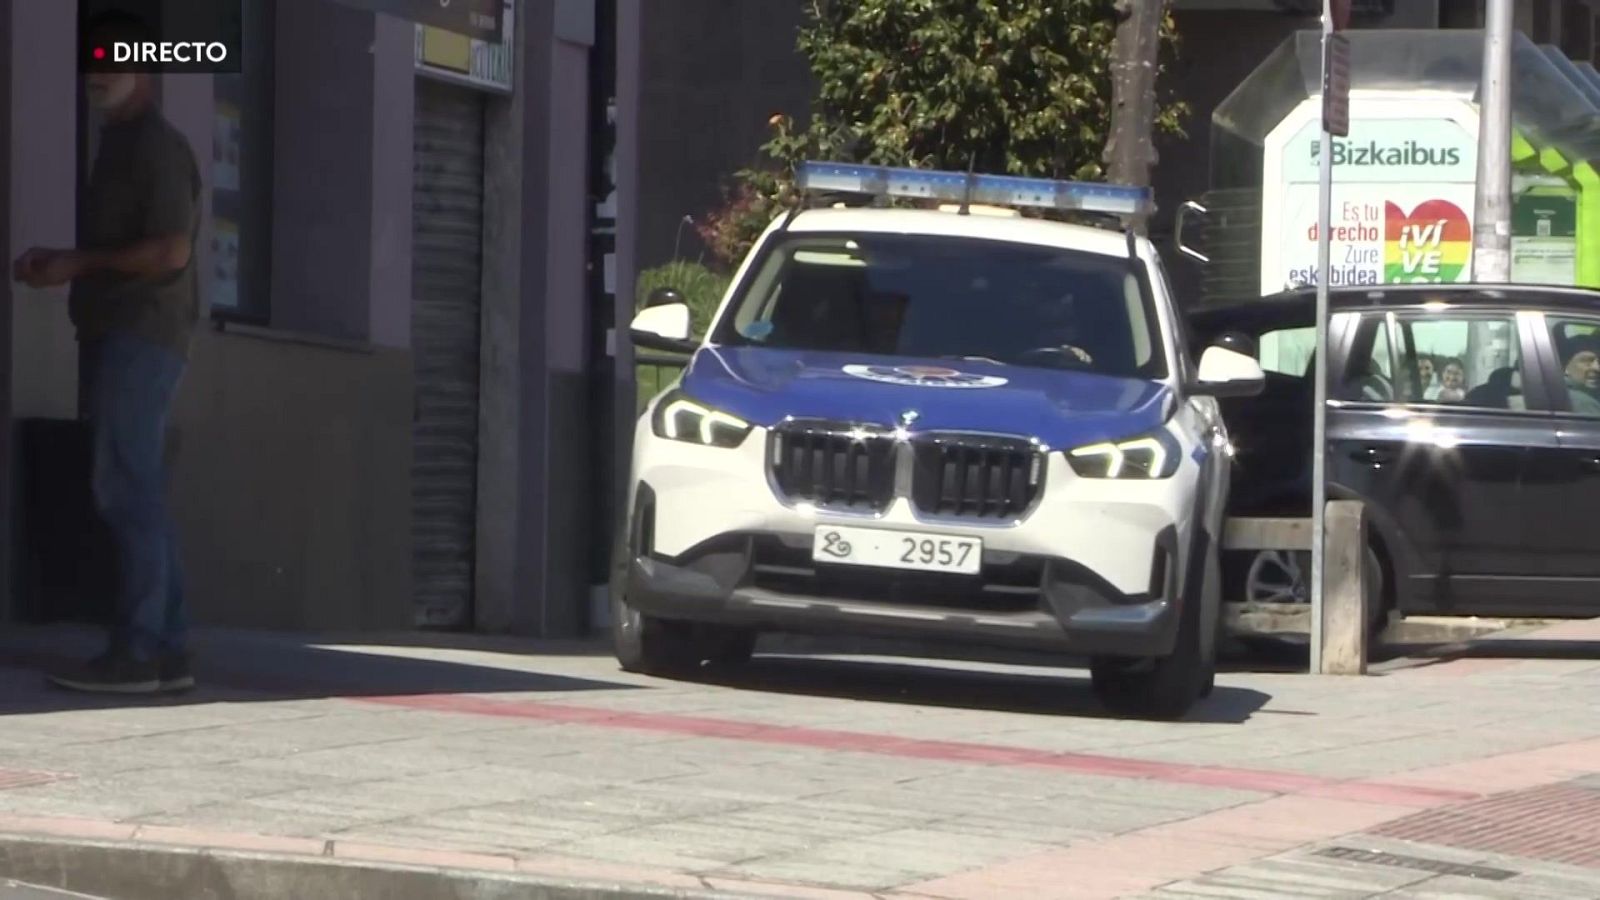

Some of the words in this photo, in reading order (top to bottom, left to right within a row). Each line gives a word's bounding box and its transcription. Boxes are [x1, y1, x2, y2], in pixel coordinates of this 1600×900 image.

[1331, 140, 1460, 166] Bizkaibus
[1343, 201, 1360, 221] Es
[1364, 203, 1379, 221] tu
[1308, 221, 1379, 242] drecho
[1345, 244, 1379, 264] Zure
[1402, 250, 1443, 274] VE
[1289, 264, 1378, 286] eskbidea
[900, 537, 973, 567] 2957
